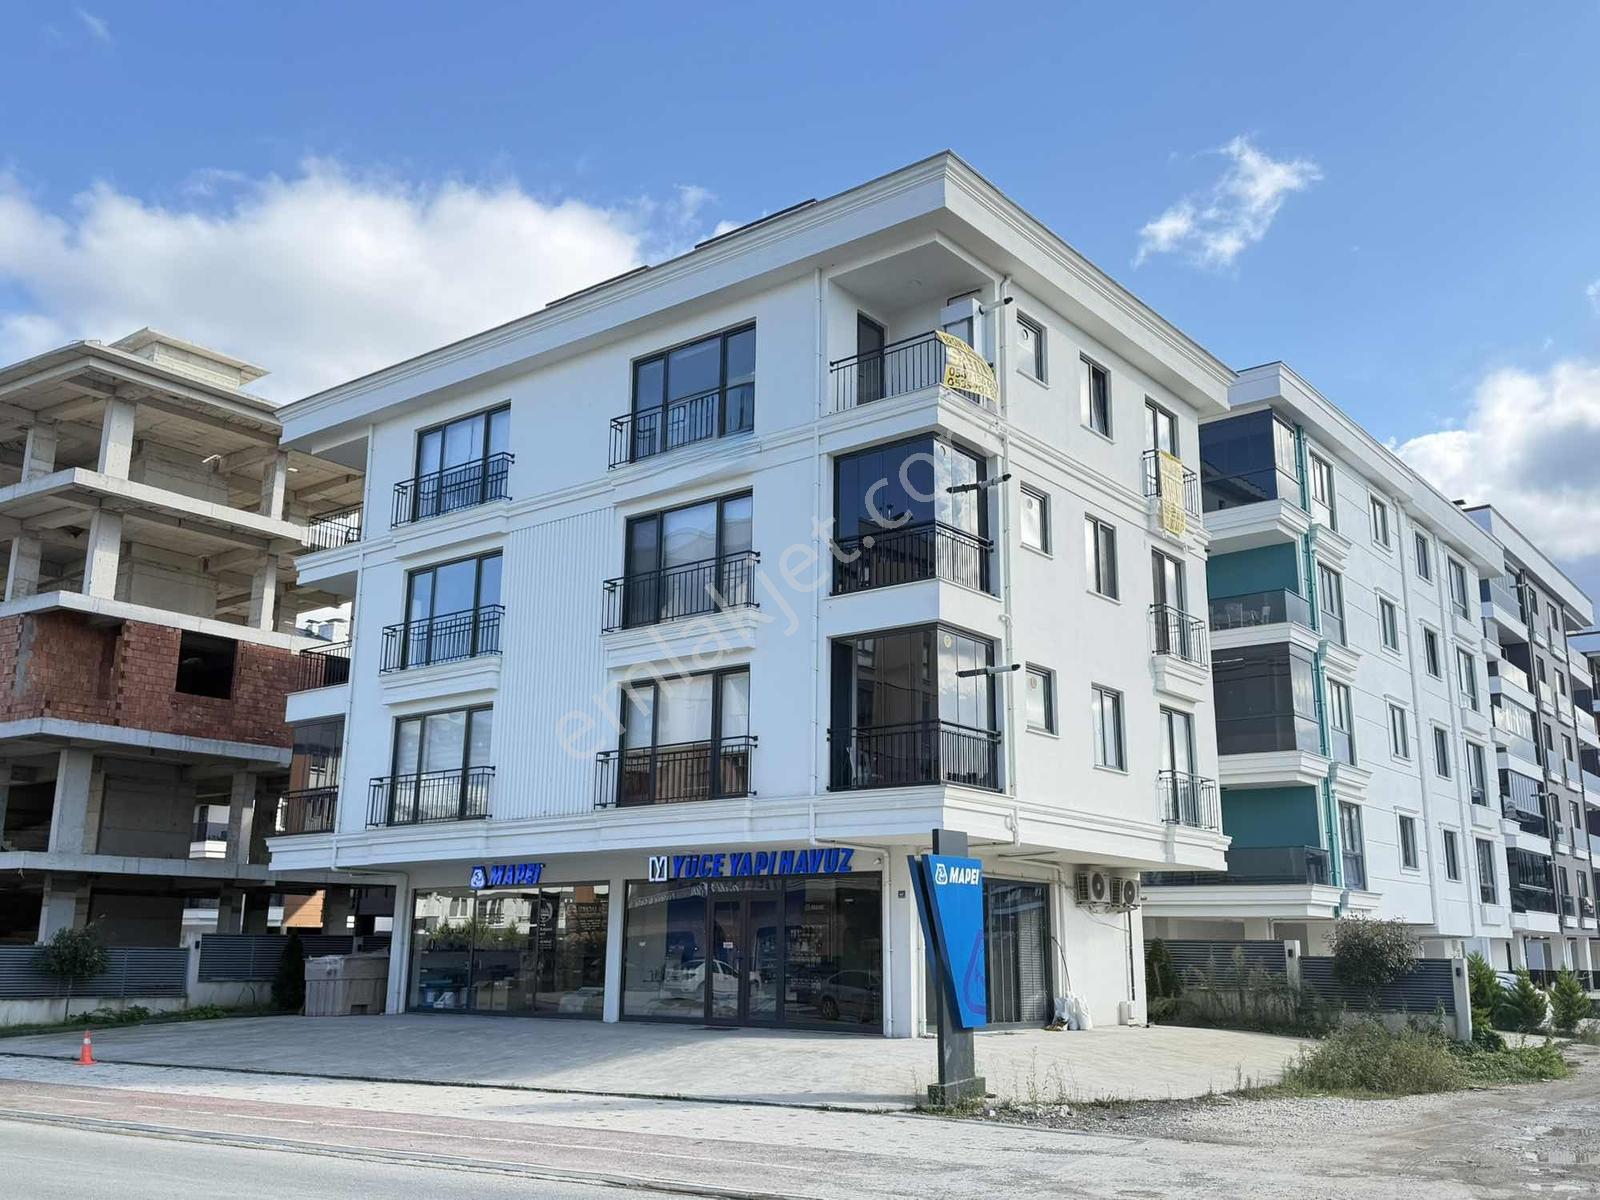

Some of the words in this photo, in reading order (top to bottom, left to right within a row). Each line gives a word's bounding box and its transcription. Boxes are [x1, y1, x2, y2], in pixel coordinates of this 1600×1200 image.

[489, 863, 544, 885] MAPEI
[673, 853, 726, 878] YÜCE
[730, 850, 777, 876] YAPI
[778, 848, 854, 875] HAVUZ
[949, 866, 980, 885] MAPEI
